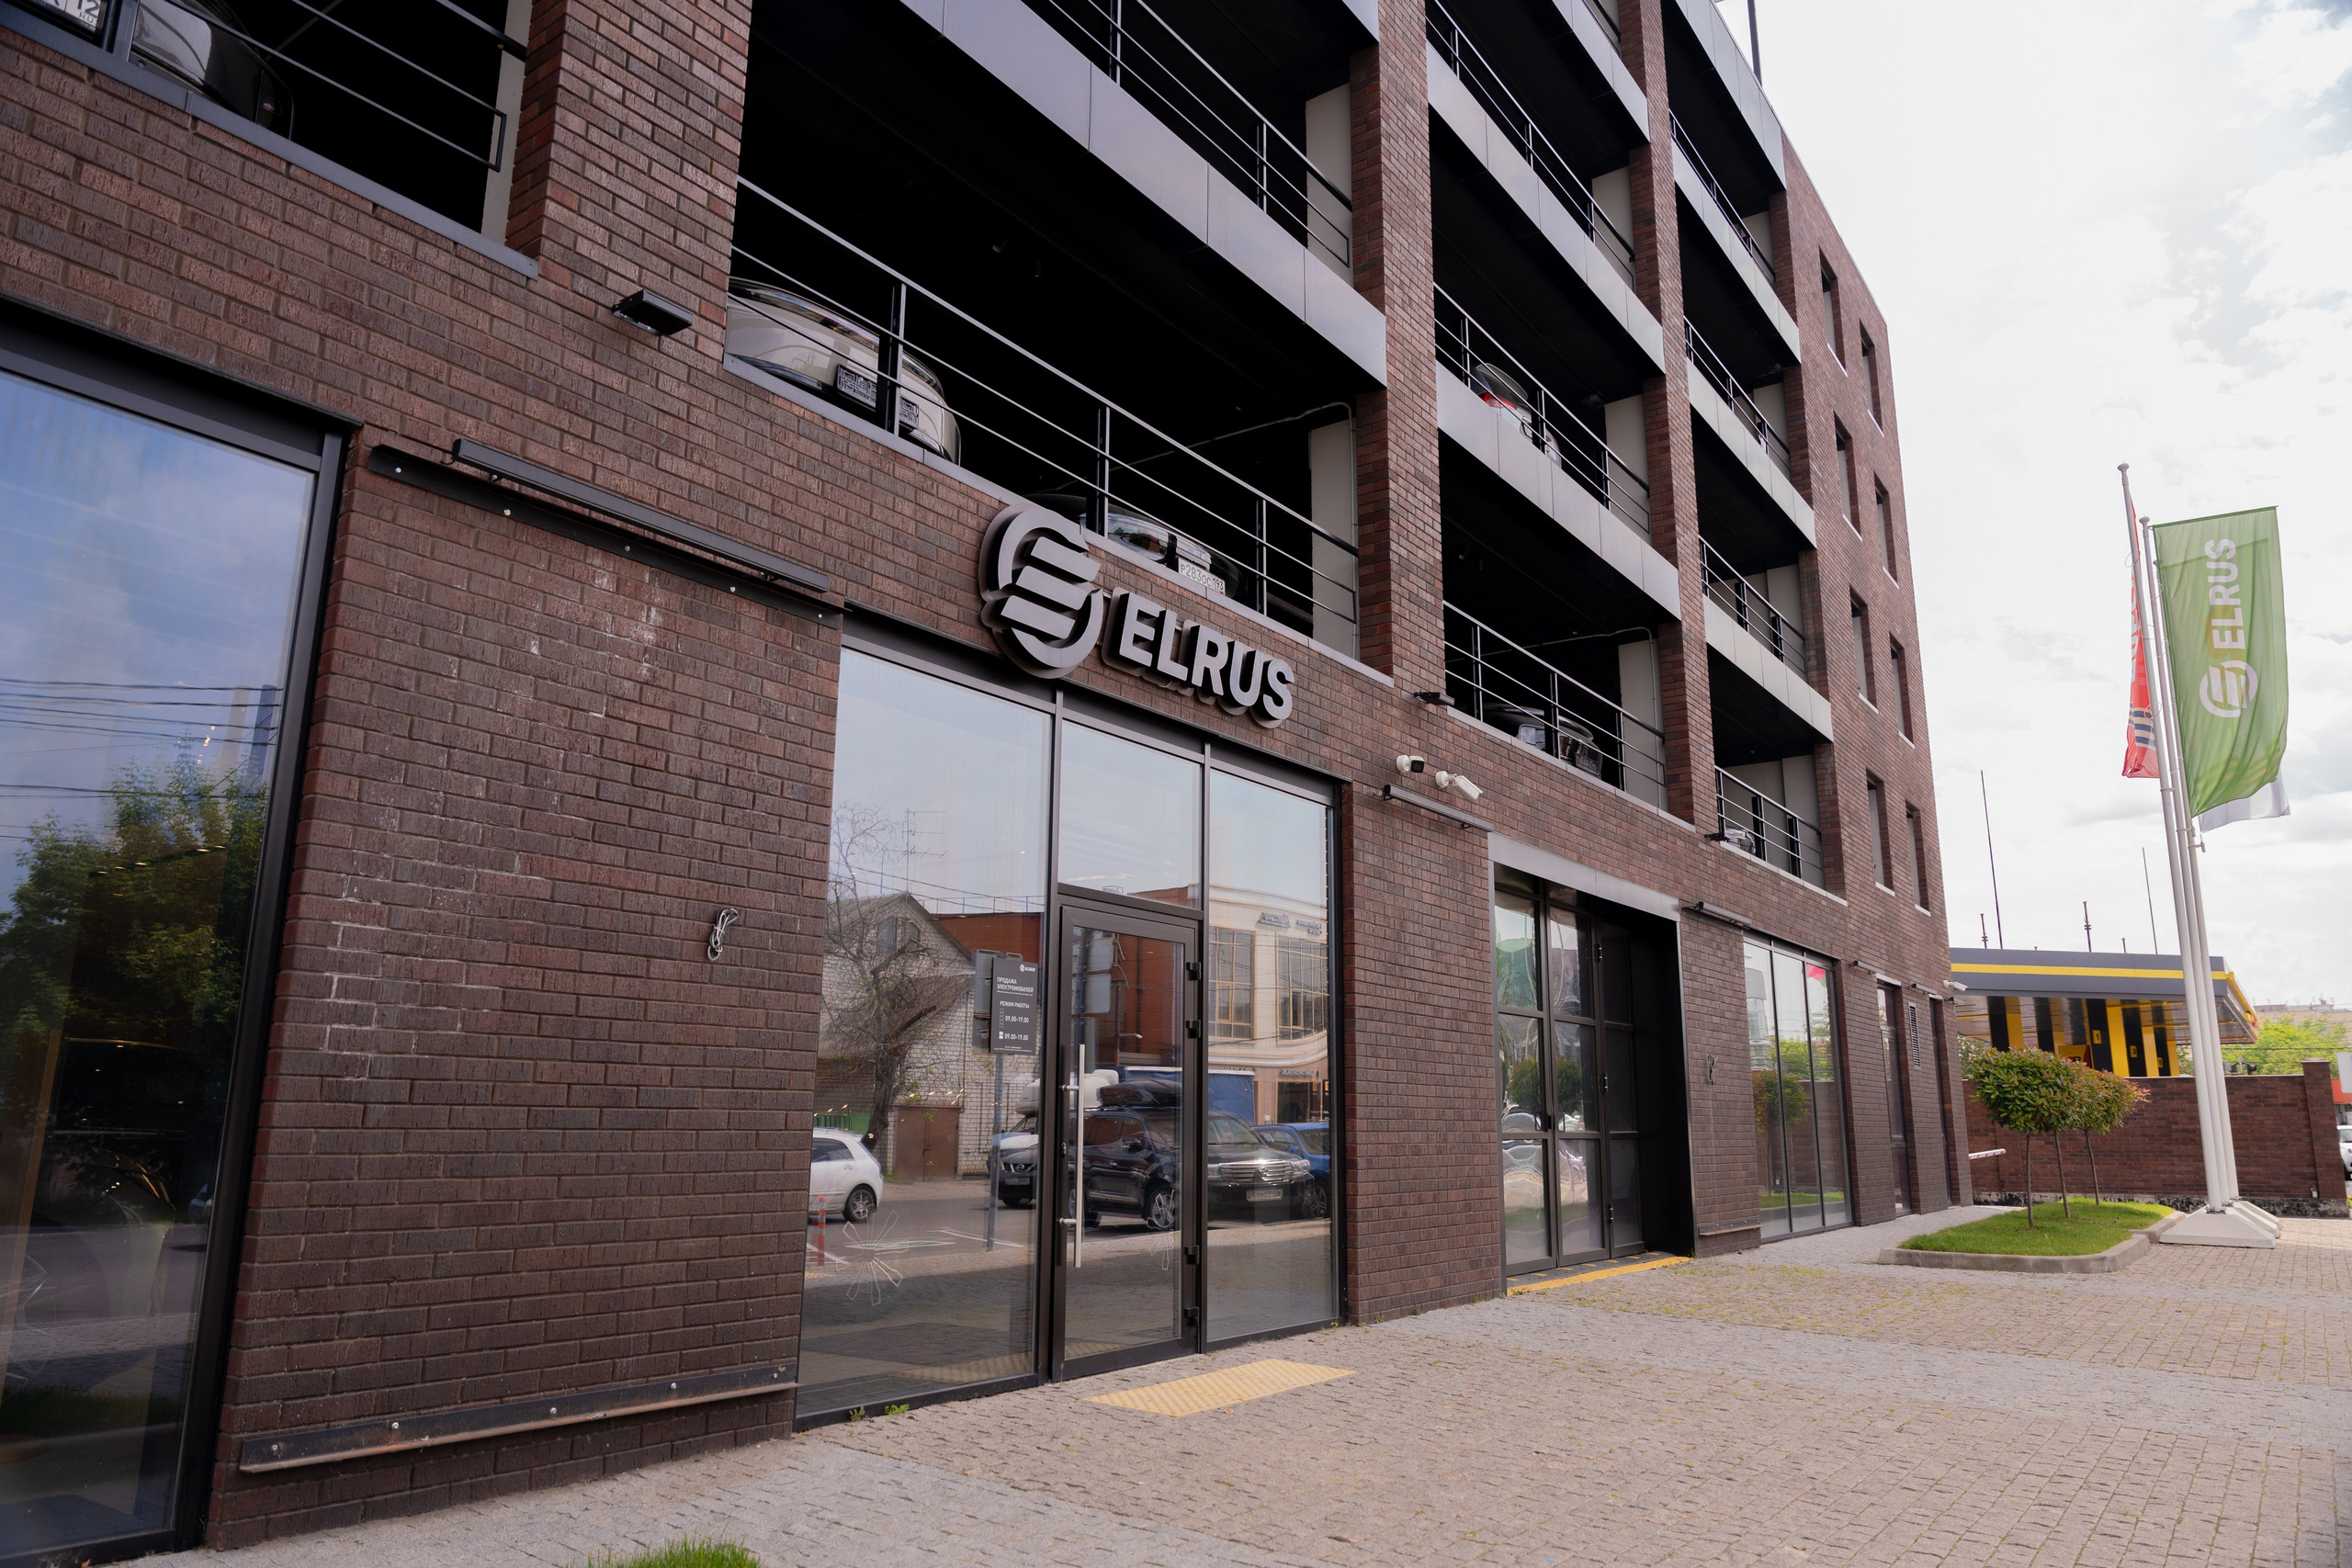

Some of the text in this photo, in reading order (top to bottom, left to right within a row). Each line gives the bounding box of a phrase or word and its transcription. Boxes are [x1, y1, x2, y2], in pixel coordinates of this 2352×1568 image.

[79, 12, 96, 24] RU
[2205, 538, 2245, 649] ELRUS
[1115, 592, 1295, 721] ELRUS
[997, 976, 1017, 985] ПРОДАЖА
[997, 983, 1034, 993] ЭЛЕКТРОМОБИЛЕЙ
[1005, 1015, 1029, 1023] 09.00-19.00
